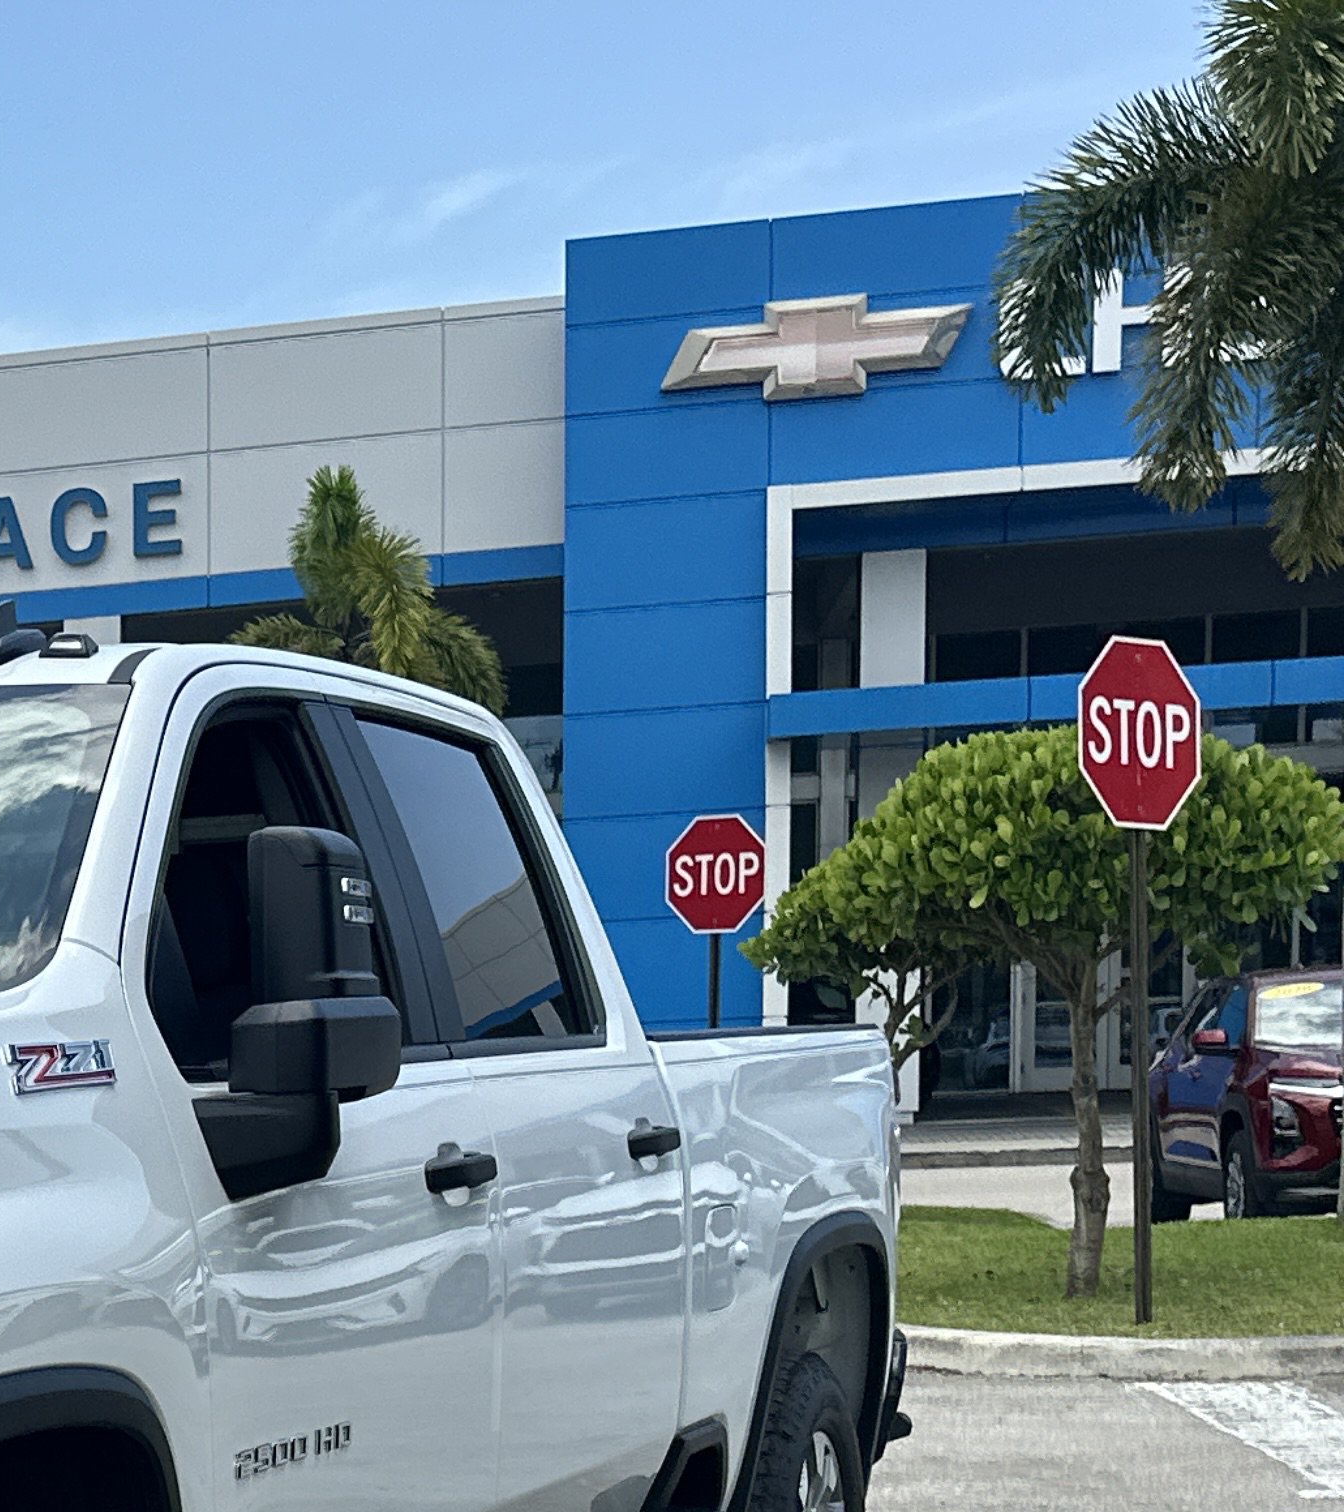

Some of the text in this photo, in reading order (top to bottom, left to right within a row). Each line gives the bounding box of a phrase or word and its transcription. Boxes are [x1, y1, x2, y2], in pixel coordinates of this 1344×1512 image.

[1088, 695, 1190, 769] STOP
[673, 851, 759, 897] STOP
[1, 1040, 116, 1095] Z71
[234, 1420, 351, 1480] 2500 HD
